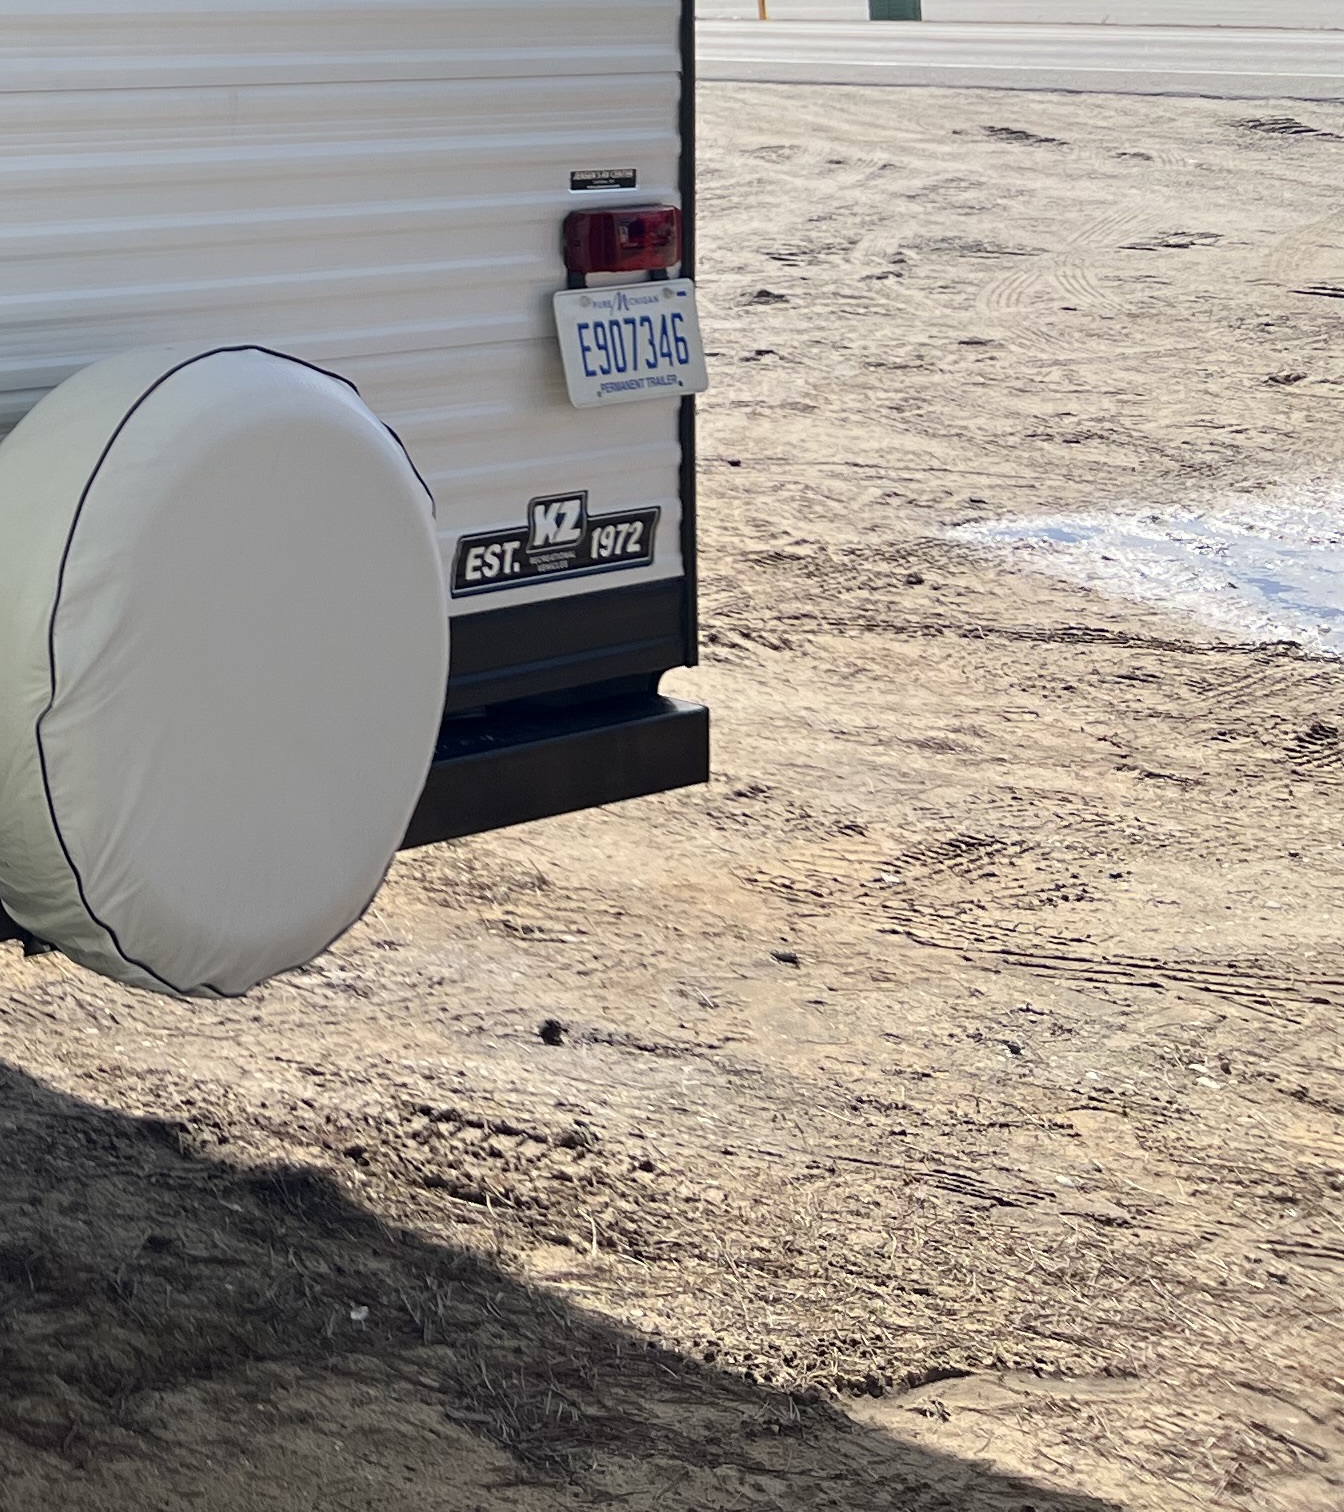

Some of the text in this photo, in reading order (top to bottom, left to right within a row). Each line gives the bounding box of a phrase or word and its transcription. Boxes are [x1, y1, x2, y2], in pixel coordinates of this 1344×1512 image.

[577, 313, 689, 377] E907346
[600, 374, 678, 394] PERMANENT TRAILER
[533, 499, 581, 546] KZ
[465, 521, 643, 580] EST. 1972
